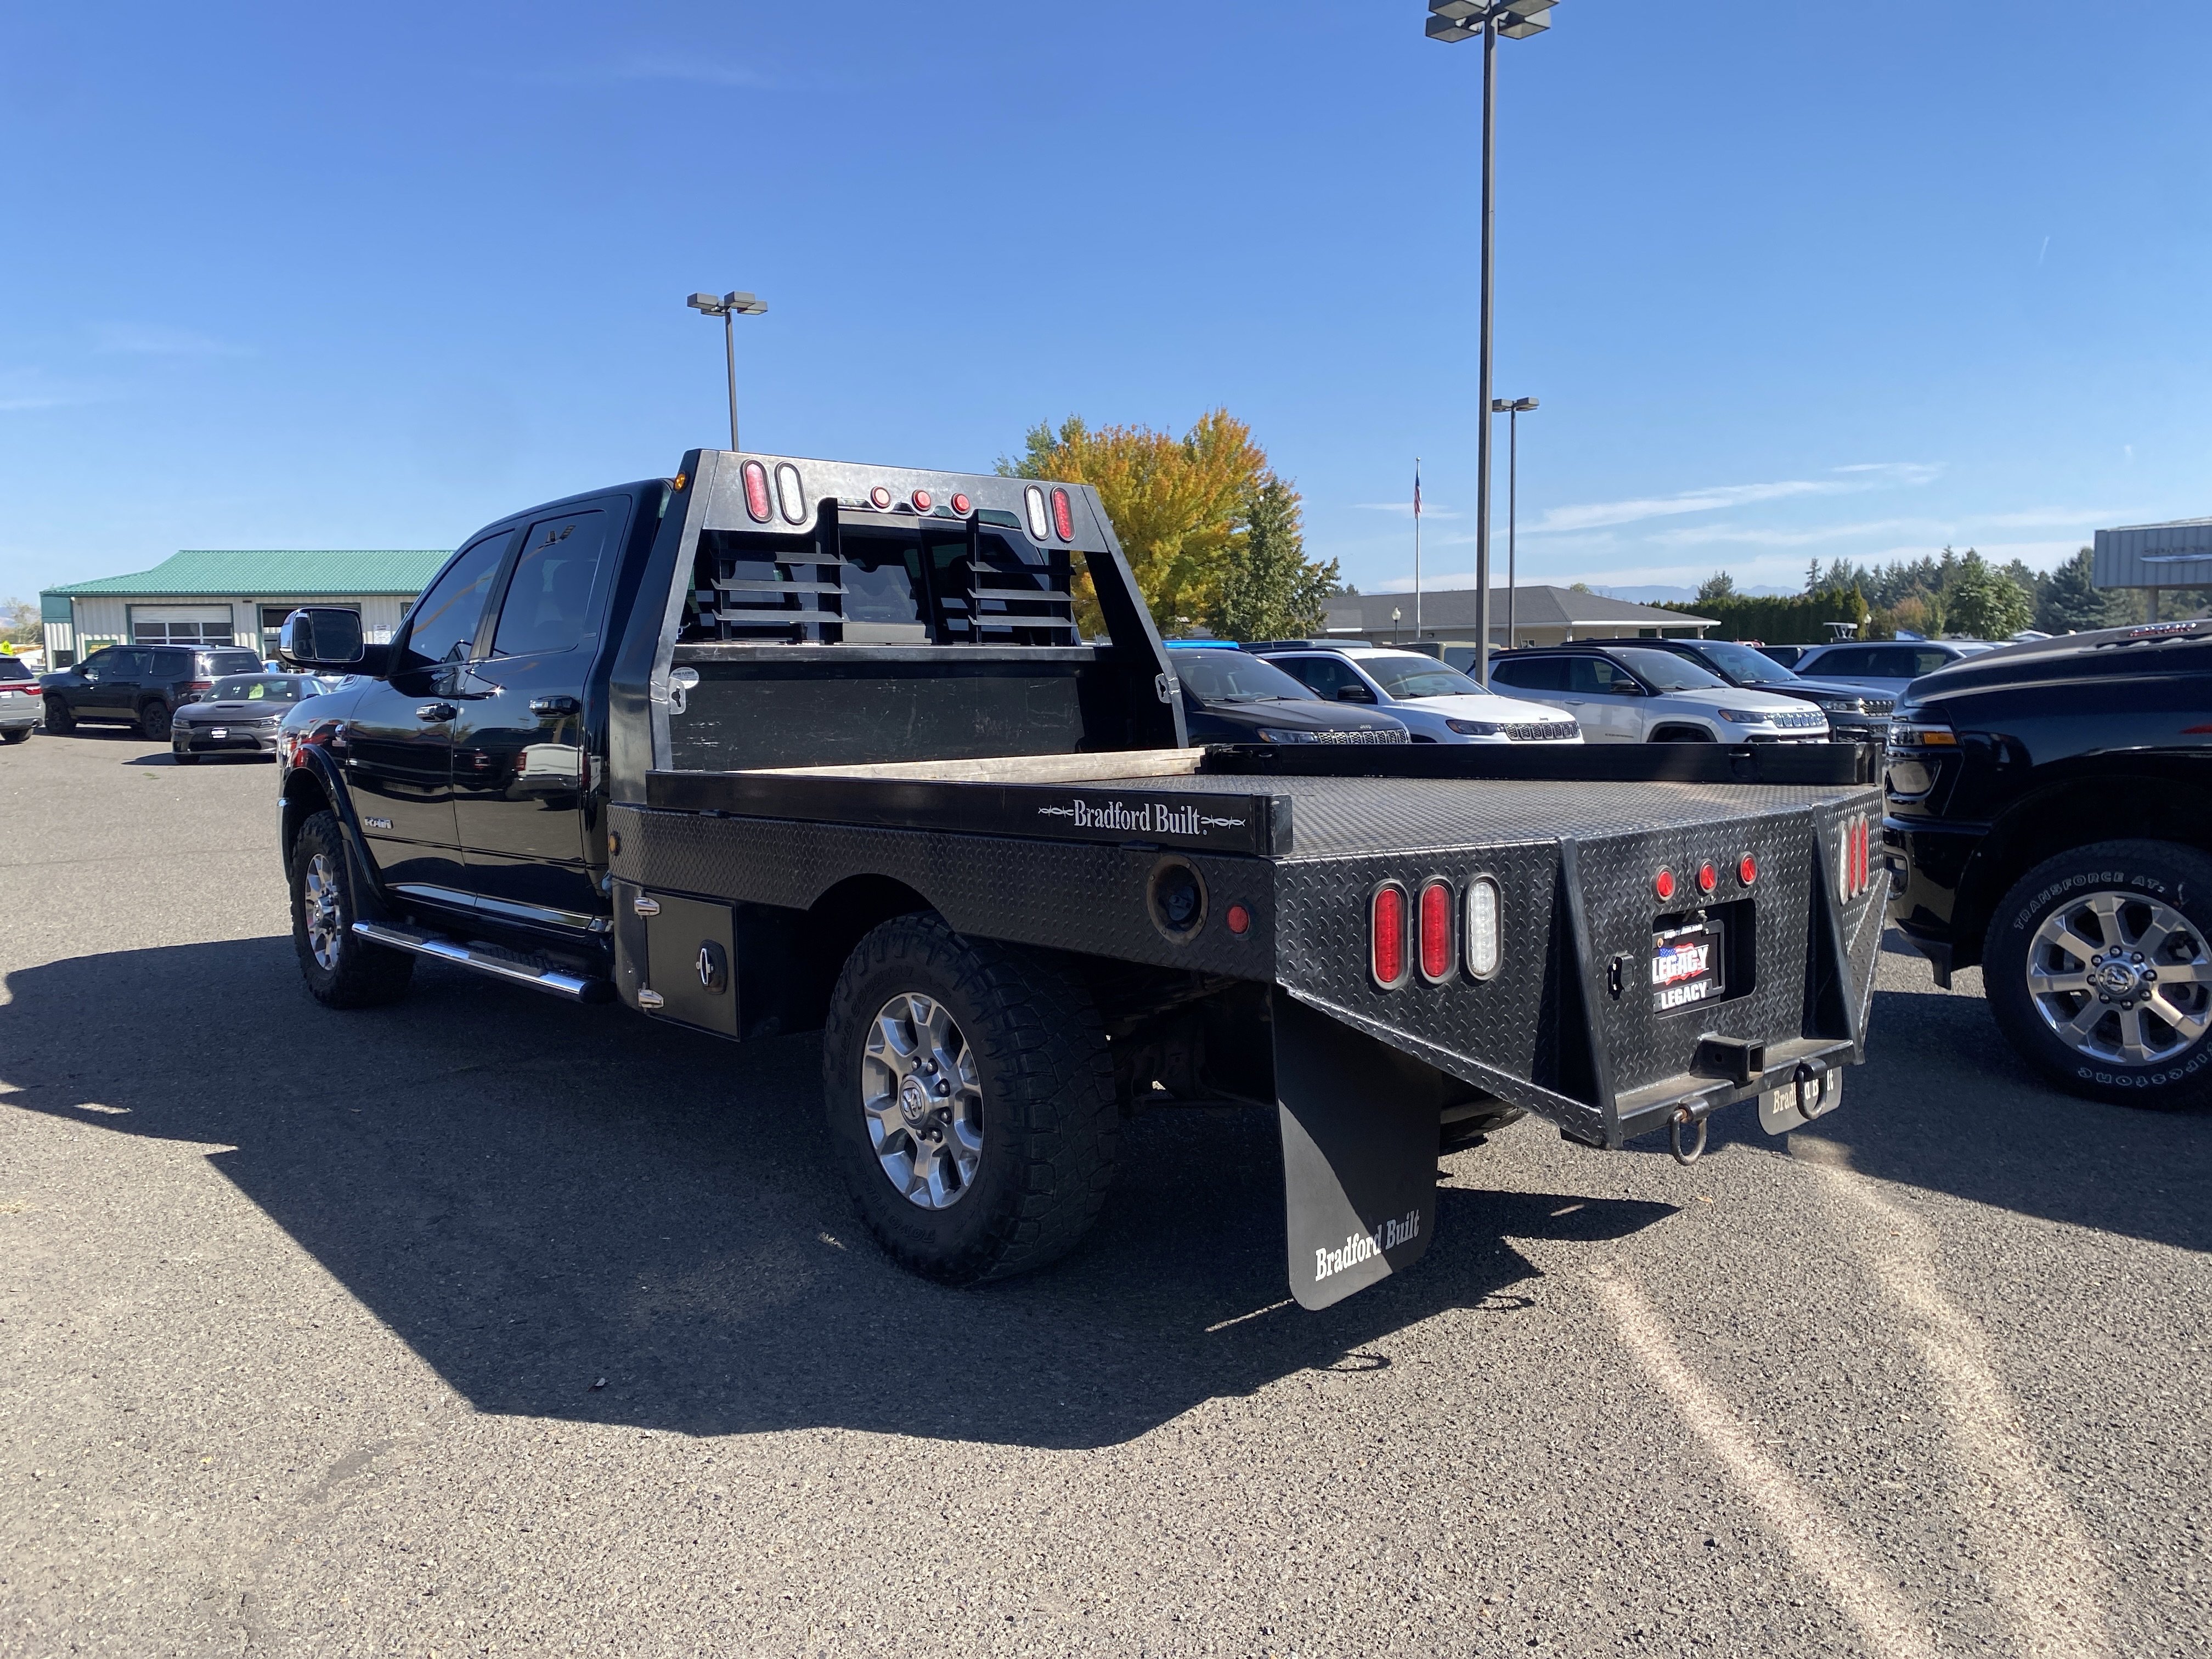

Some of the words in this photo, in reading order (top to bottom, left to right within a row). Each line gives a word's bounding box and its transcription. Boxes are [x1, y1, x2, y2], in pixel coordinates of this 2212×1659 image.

[1073, 799, 1152, 832] Bradford
[2013, 871, 2124, 930] TRANSFORCE
[1652, 946, 1709, 983] LEGACY
[1661, 981, 1707, 1010] LEGACY
[1314, 1224, 1383, 1282] Bradford
[1385, 1209, 1420, 1250] Built
